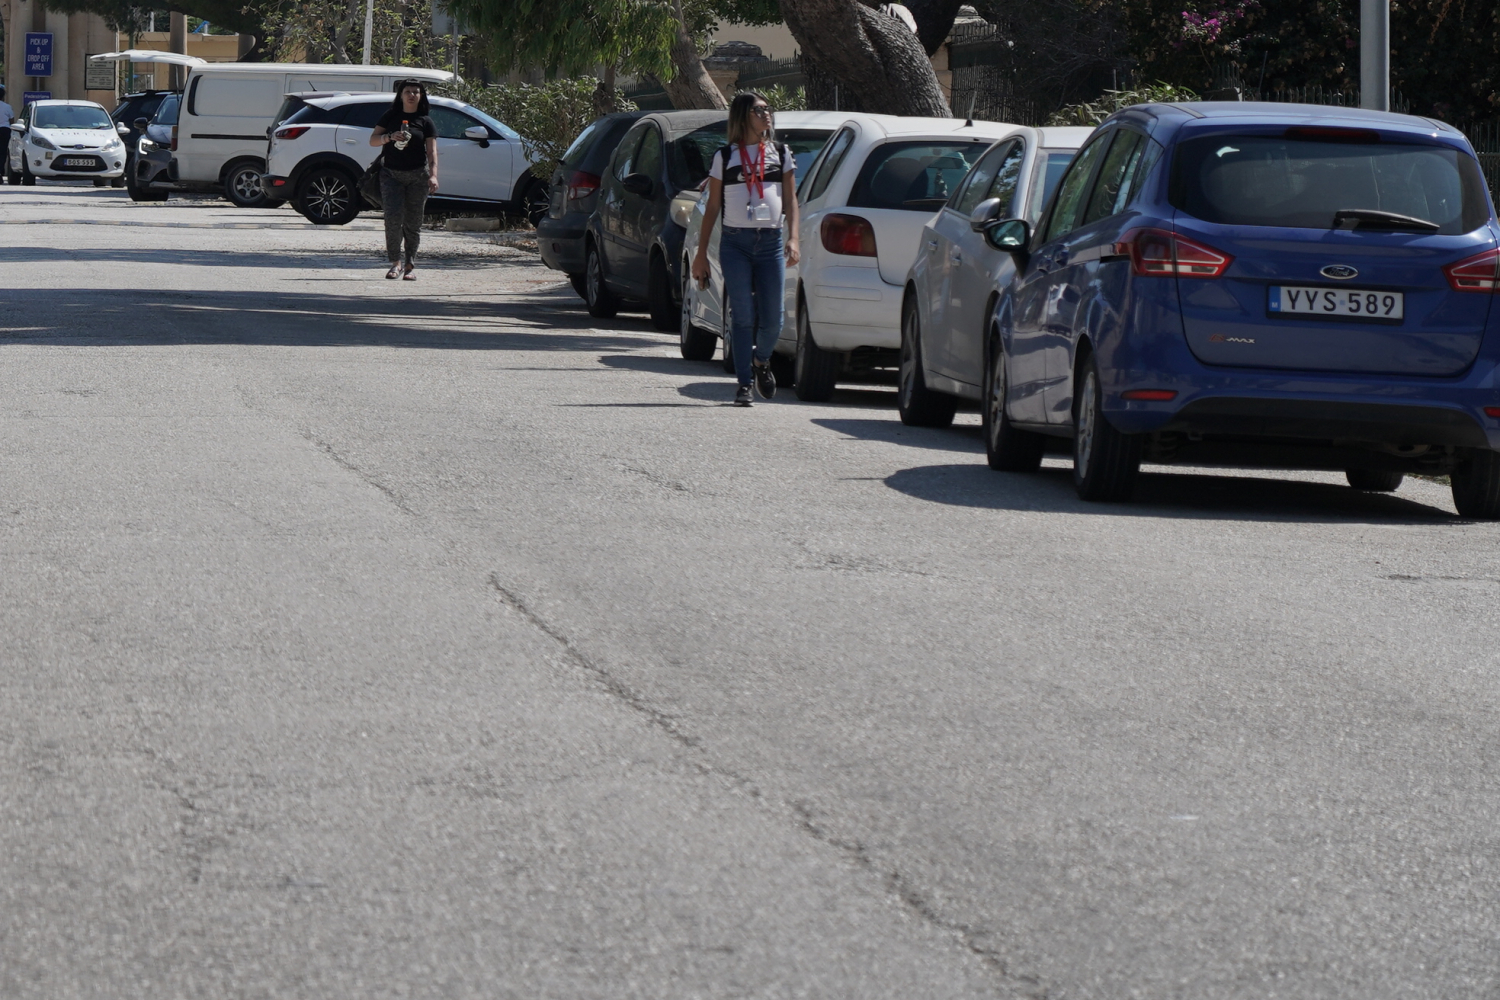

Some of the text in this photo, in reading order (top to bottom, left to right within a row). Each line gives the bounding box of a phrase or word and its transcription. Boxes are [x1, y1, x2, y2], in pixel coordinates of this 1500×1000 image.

[30, 38, 48, 46] PICK UP
[31, 63, 45, 71] AREA
